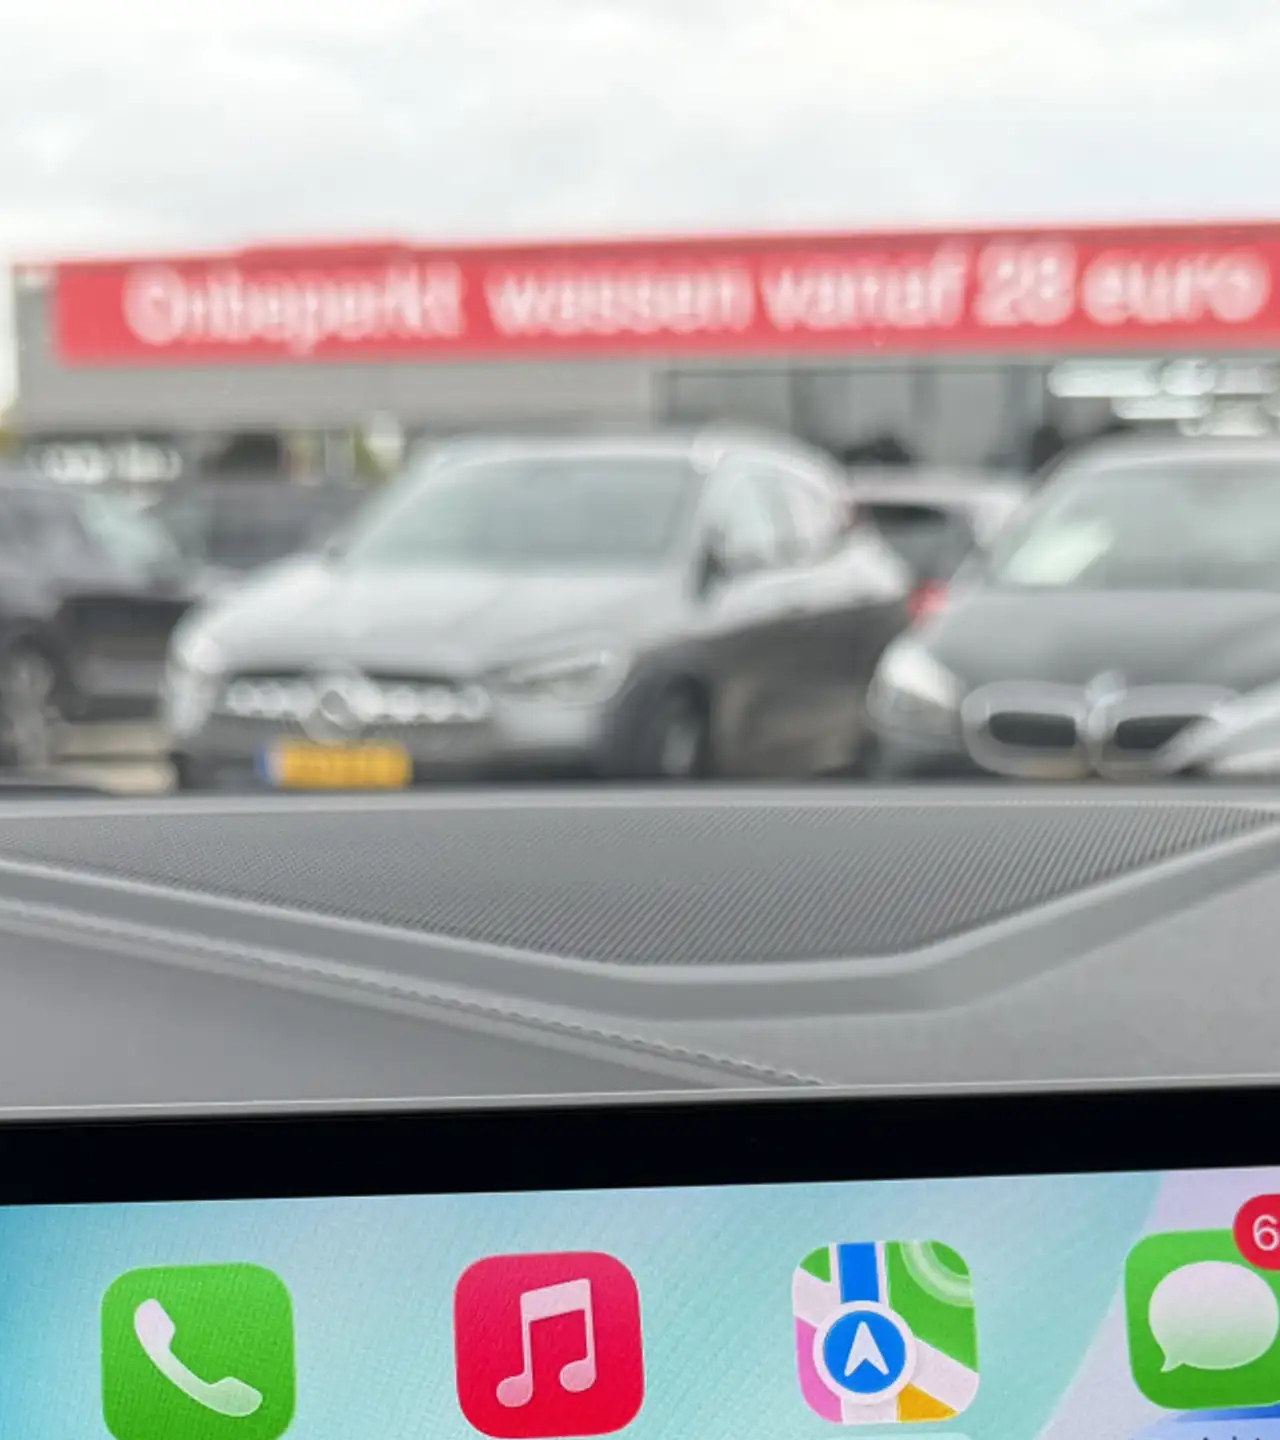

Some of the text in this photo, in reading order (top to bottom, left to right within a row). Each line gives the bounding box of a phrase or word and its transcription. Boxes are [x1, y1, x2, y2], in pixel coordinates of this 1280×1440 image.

[486, 255, 754, 336] wassen
[762, 240, 968, 331] vanaf
[975, 240, 1077, 327] 28
[1081, 247, 1269, 325] euro
